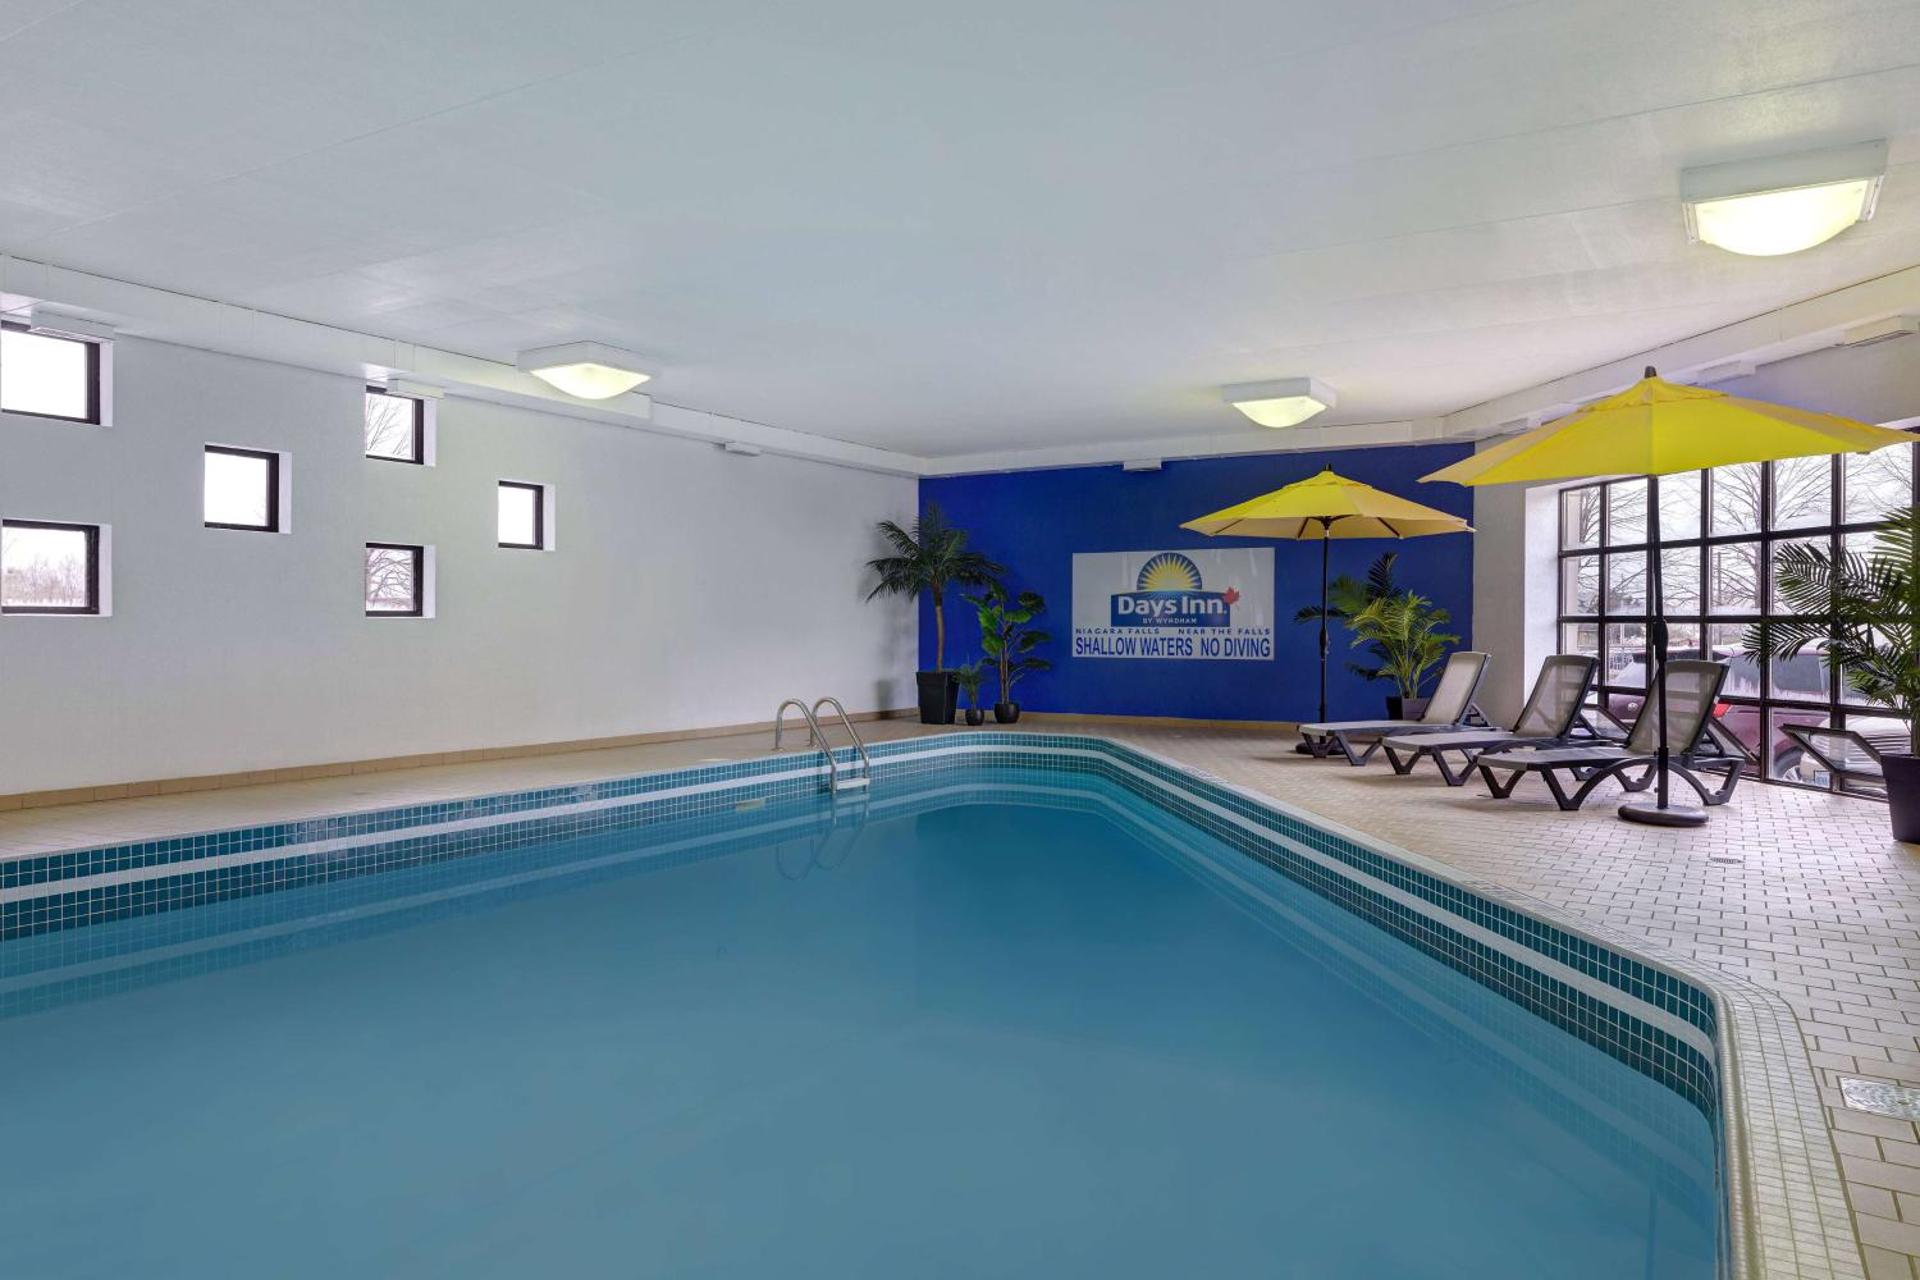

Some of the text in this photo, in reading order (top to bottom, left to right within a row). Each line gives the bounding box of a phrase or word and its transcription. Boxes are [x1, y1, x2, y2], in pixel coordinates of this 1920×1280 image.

[1118, 596, 1177, 616] Days
[1076, 637, 1270, 657] SHALLOW WATERS NO DIVING
